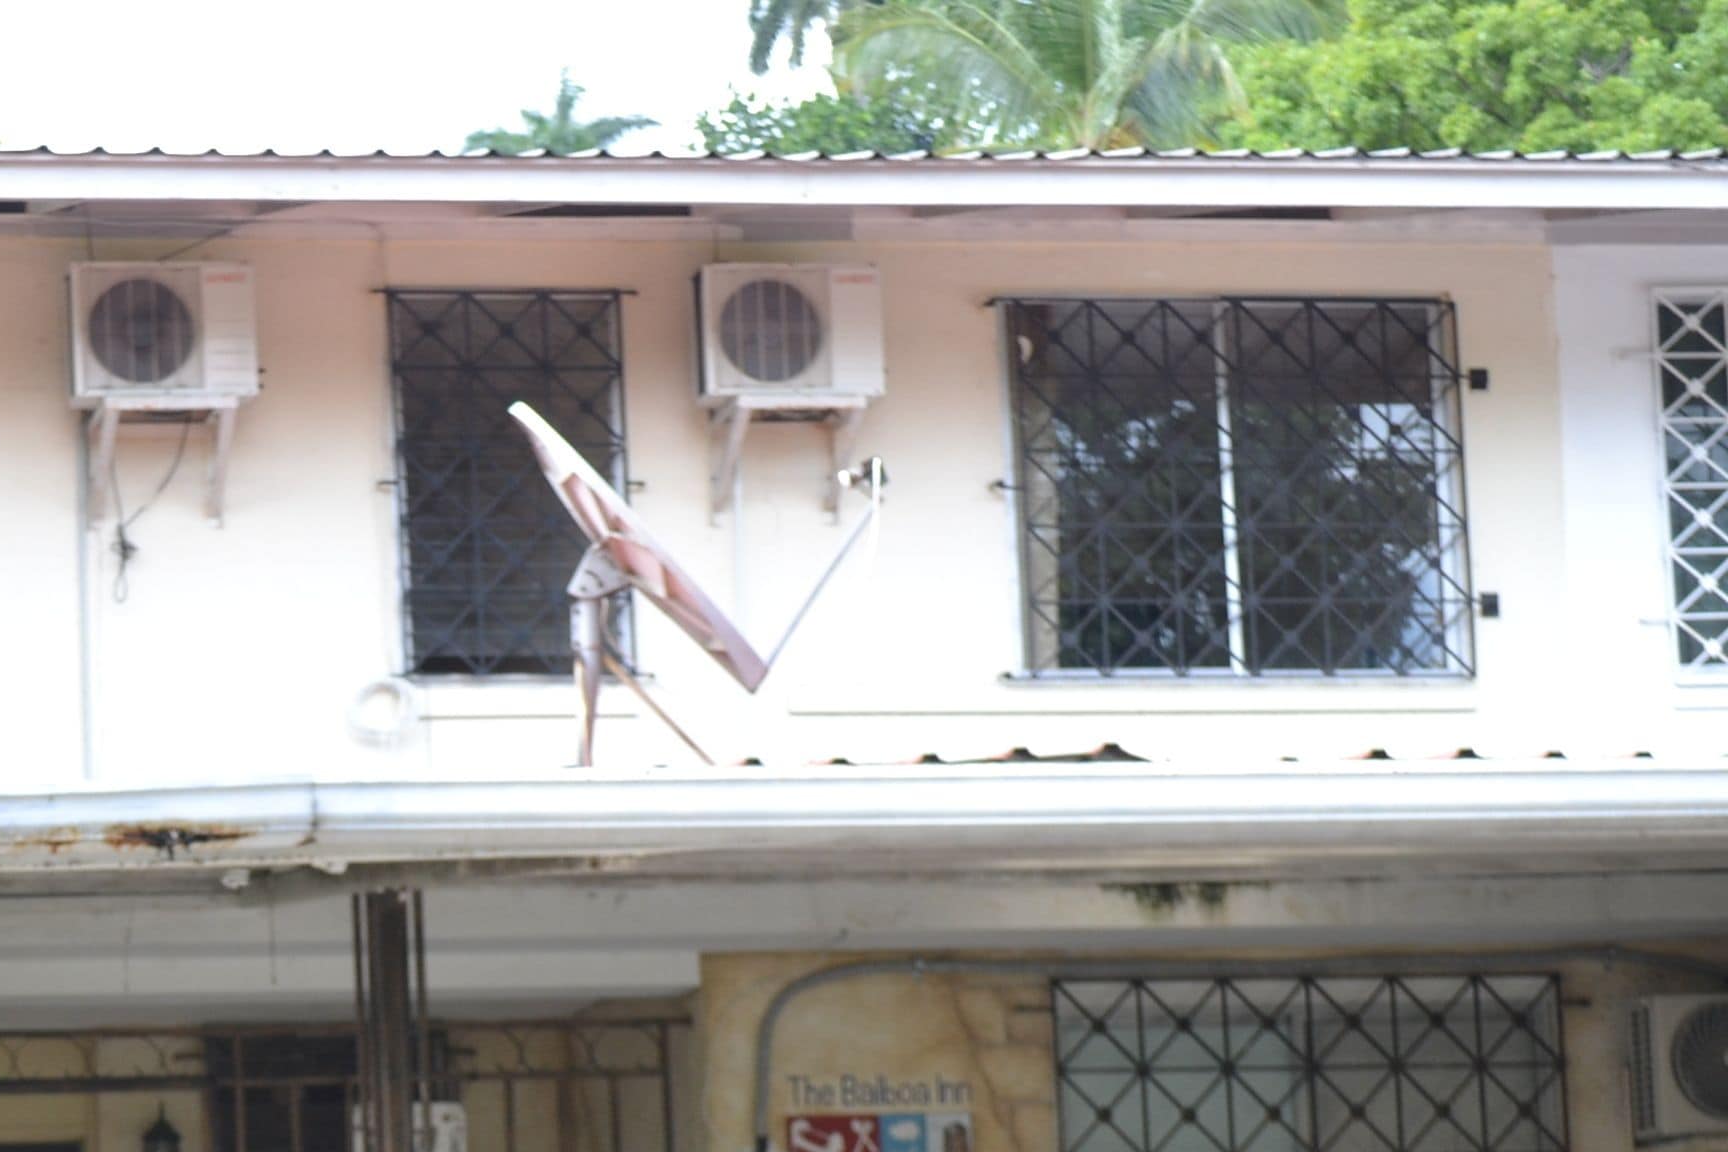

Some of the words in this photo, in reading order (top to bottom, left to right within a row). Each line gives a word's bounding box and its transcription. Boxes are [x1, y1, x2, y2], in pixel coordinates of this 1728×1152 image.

[786, 1073, 835, 1106] The
[840, 1072, 932, 1106] Balboa
[935, 1072, 972, 1104] Inn
